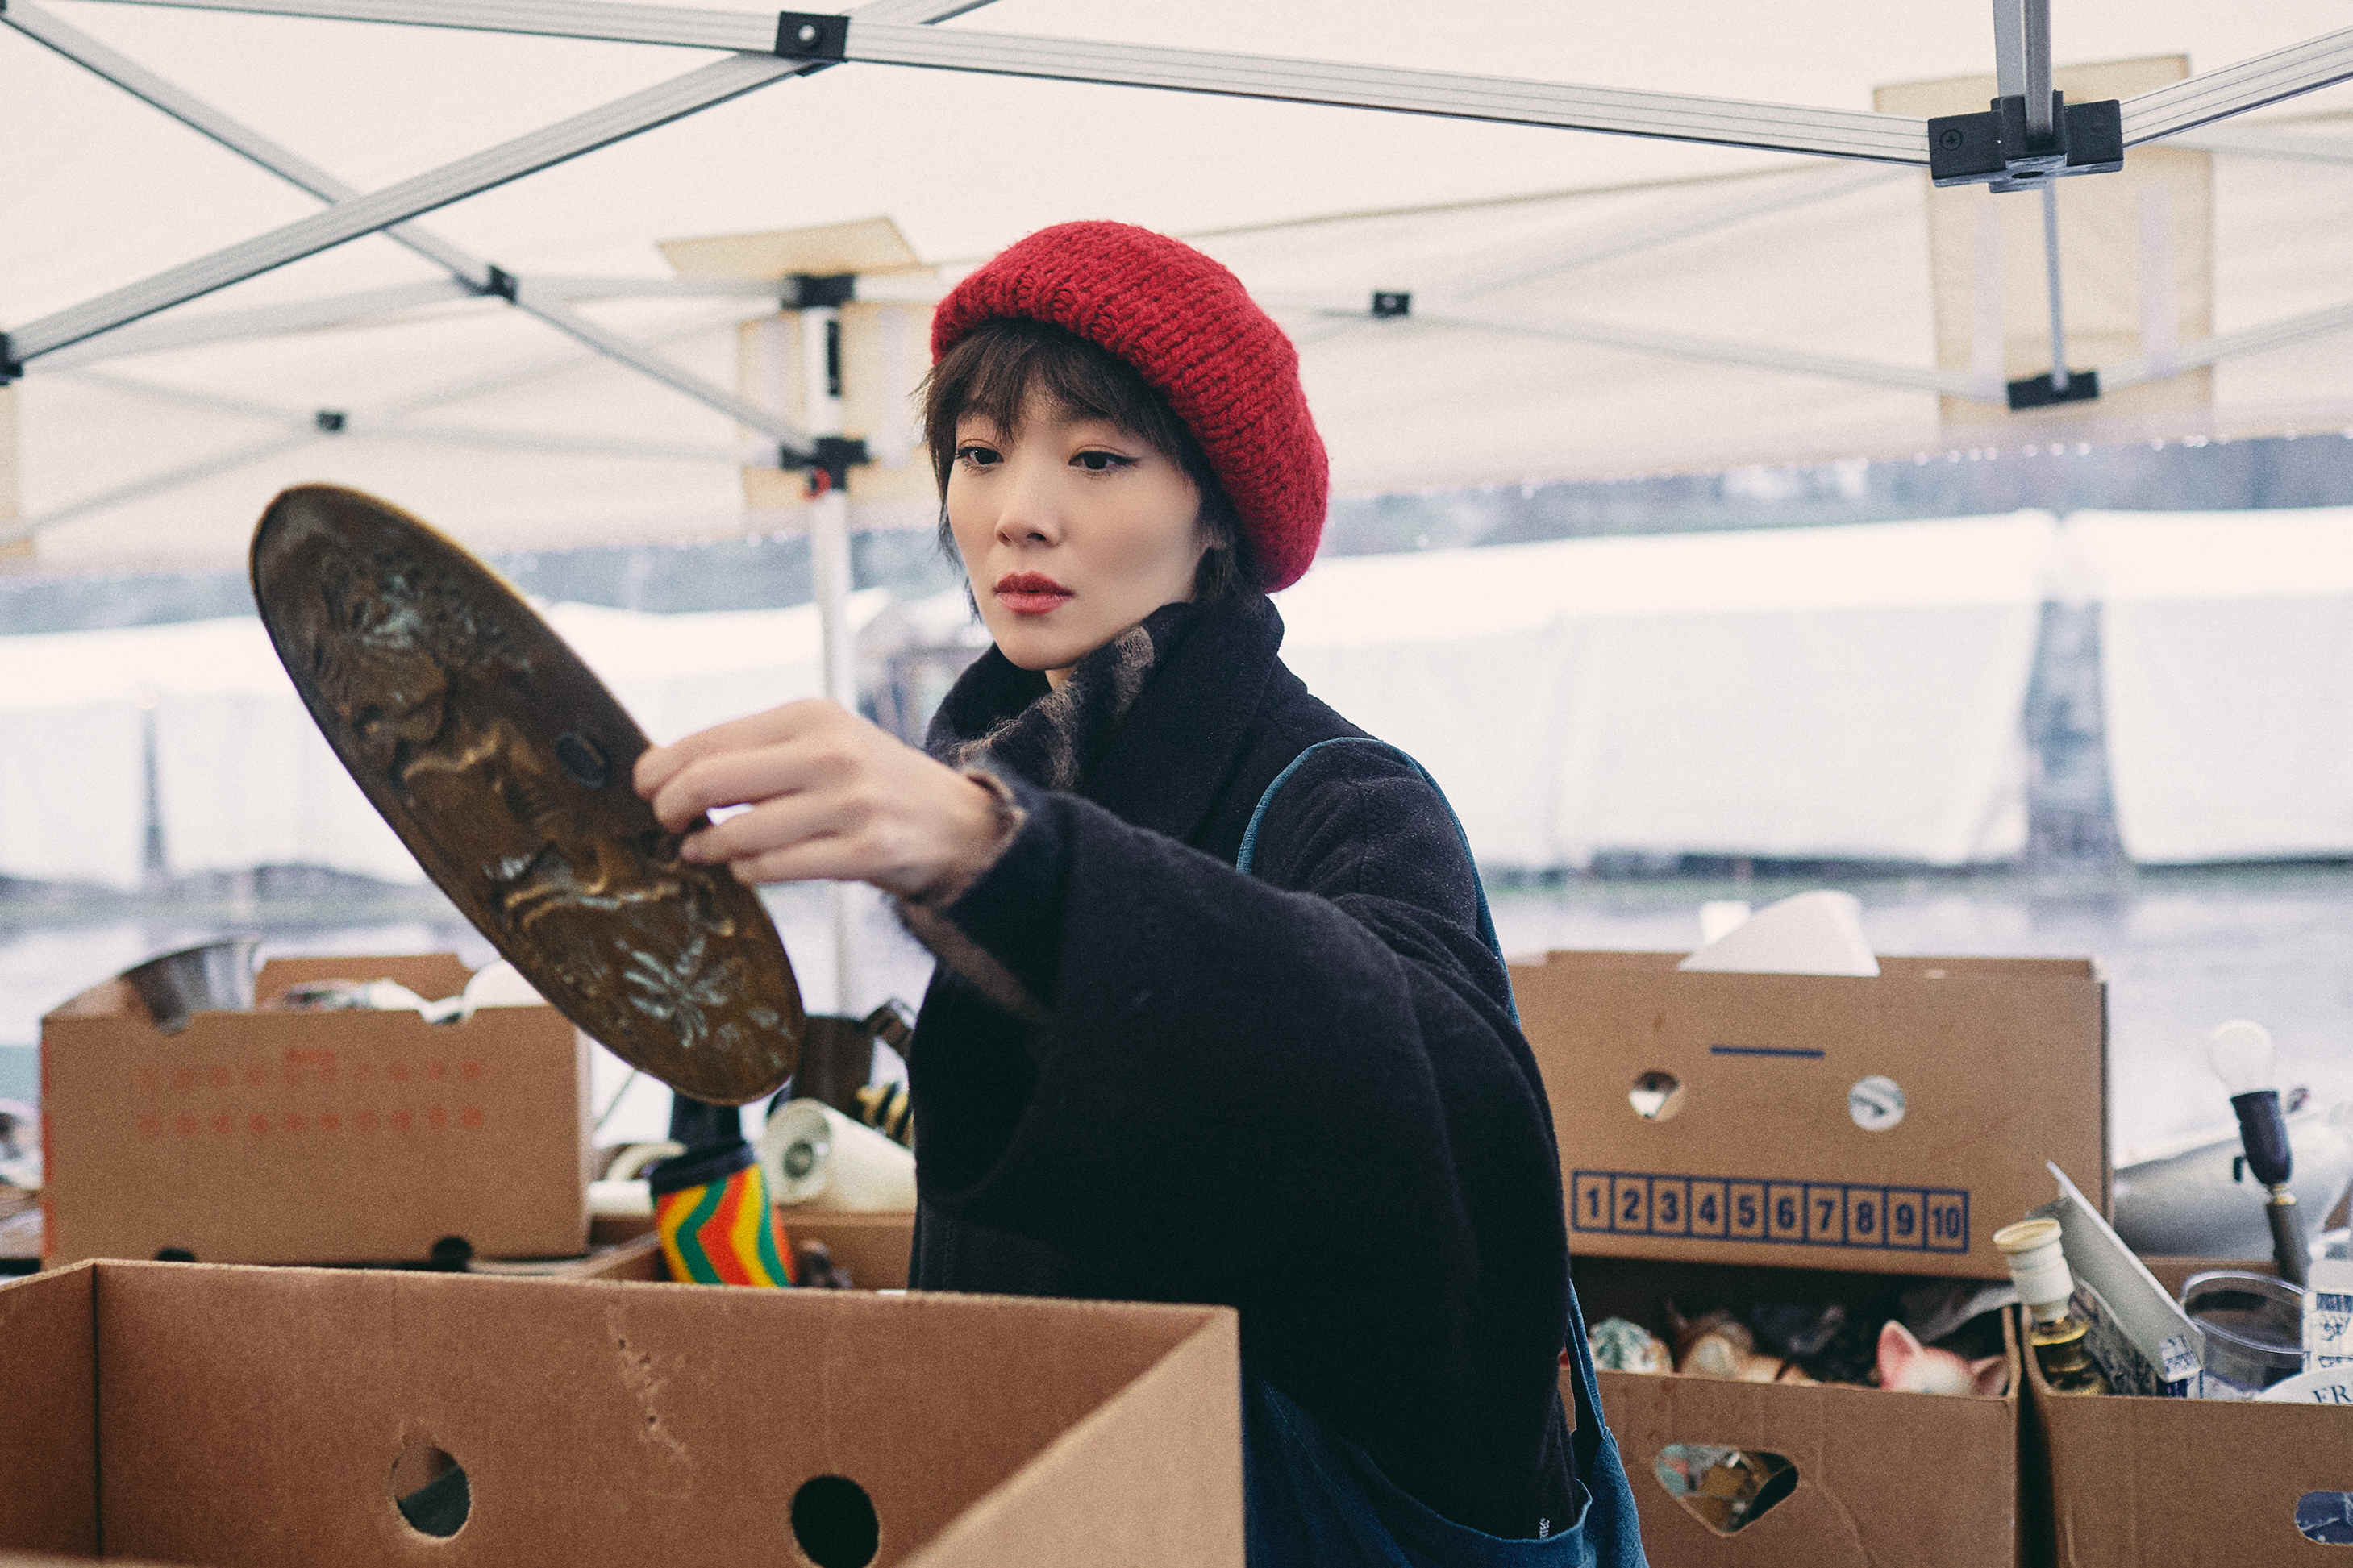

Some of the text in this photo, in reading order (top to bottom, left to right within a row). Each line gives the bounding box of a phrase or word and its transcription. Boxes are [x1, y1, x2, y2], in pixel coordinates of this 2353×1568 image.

[1587, 1187, 1961, 1239] 1 2 3 4 5 6 7 8 9 10
